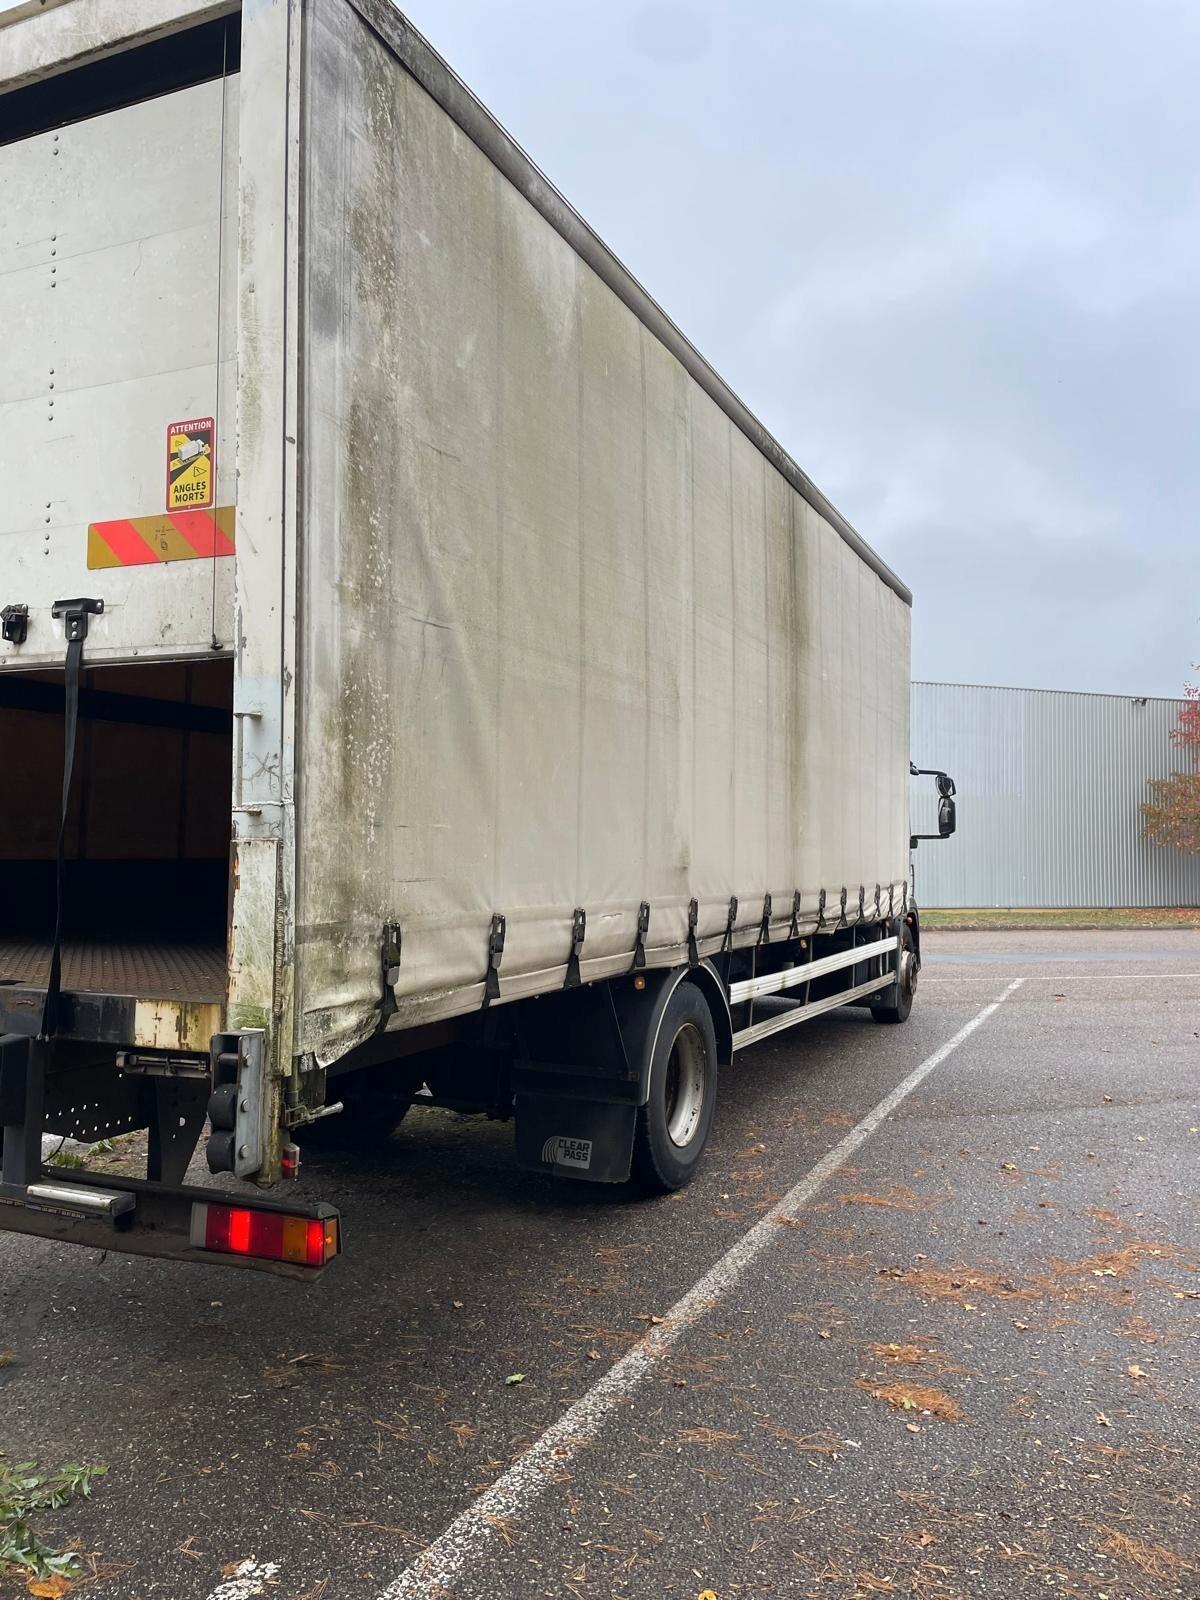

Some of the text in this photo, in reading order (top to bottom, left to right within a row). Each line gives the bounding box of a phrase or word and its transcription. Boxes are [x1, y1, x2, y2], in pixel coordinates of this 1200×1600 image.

[170, 420, 212, 434] ATTENTION
[173, 481, 206, 494] ANGLES
[175, 491, 205, 503] MORTS
[558, 1139, 590, 1152] CLEAR
[564, 1150, 588, 1162] PASS
